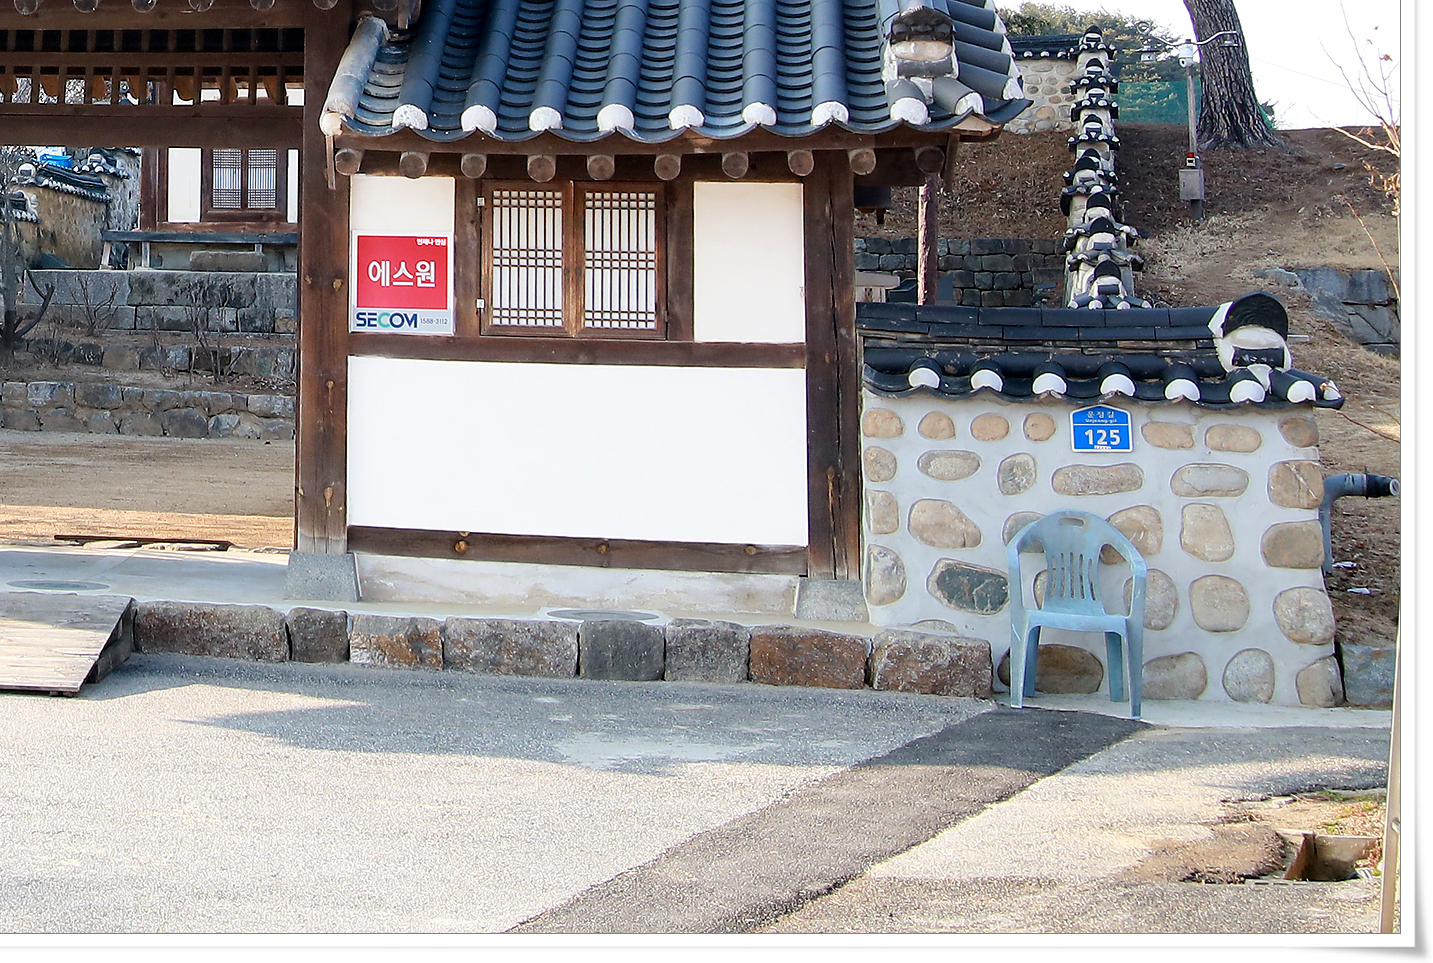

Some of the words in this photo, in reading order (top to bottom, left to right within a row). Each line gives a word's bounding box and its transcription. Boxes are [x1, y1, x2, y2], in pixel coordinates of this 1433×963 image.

[368, 260, 436, 287] 에스원
[356, 312, 418, 328] SECOM
[1085, 429, 1121, 445] 125
